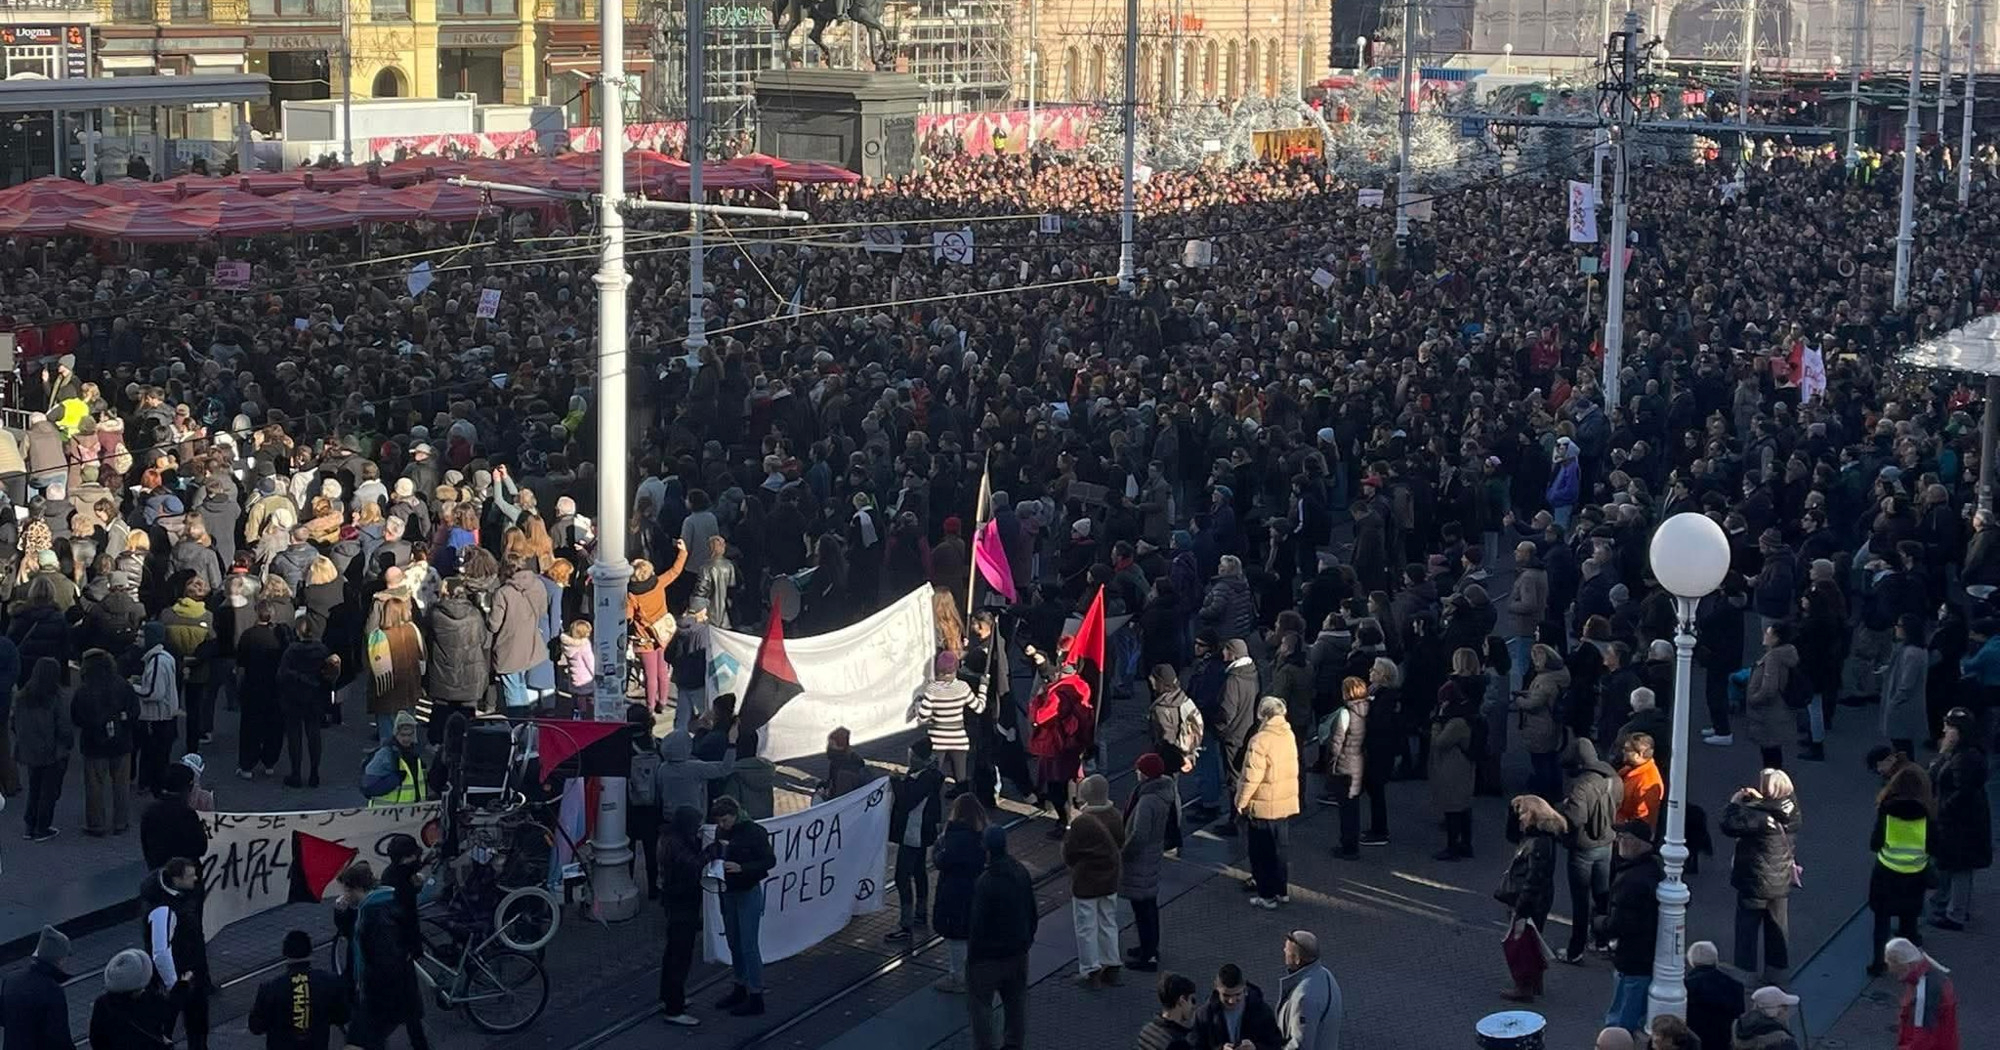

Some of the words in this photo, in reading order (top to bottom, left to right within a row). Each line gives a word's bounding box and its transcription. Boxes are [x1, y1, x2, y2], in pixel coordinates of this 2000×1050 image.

[16, 28, 51, 39] Dogma
[767, 812, 842, 863] ТИФА
[763, 857, 836, 912] ГРЕБ
[293, 984, 305, 1029] ALPHA
